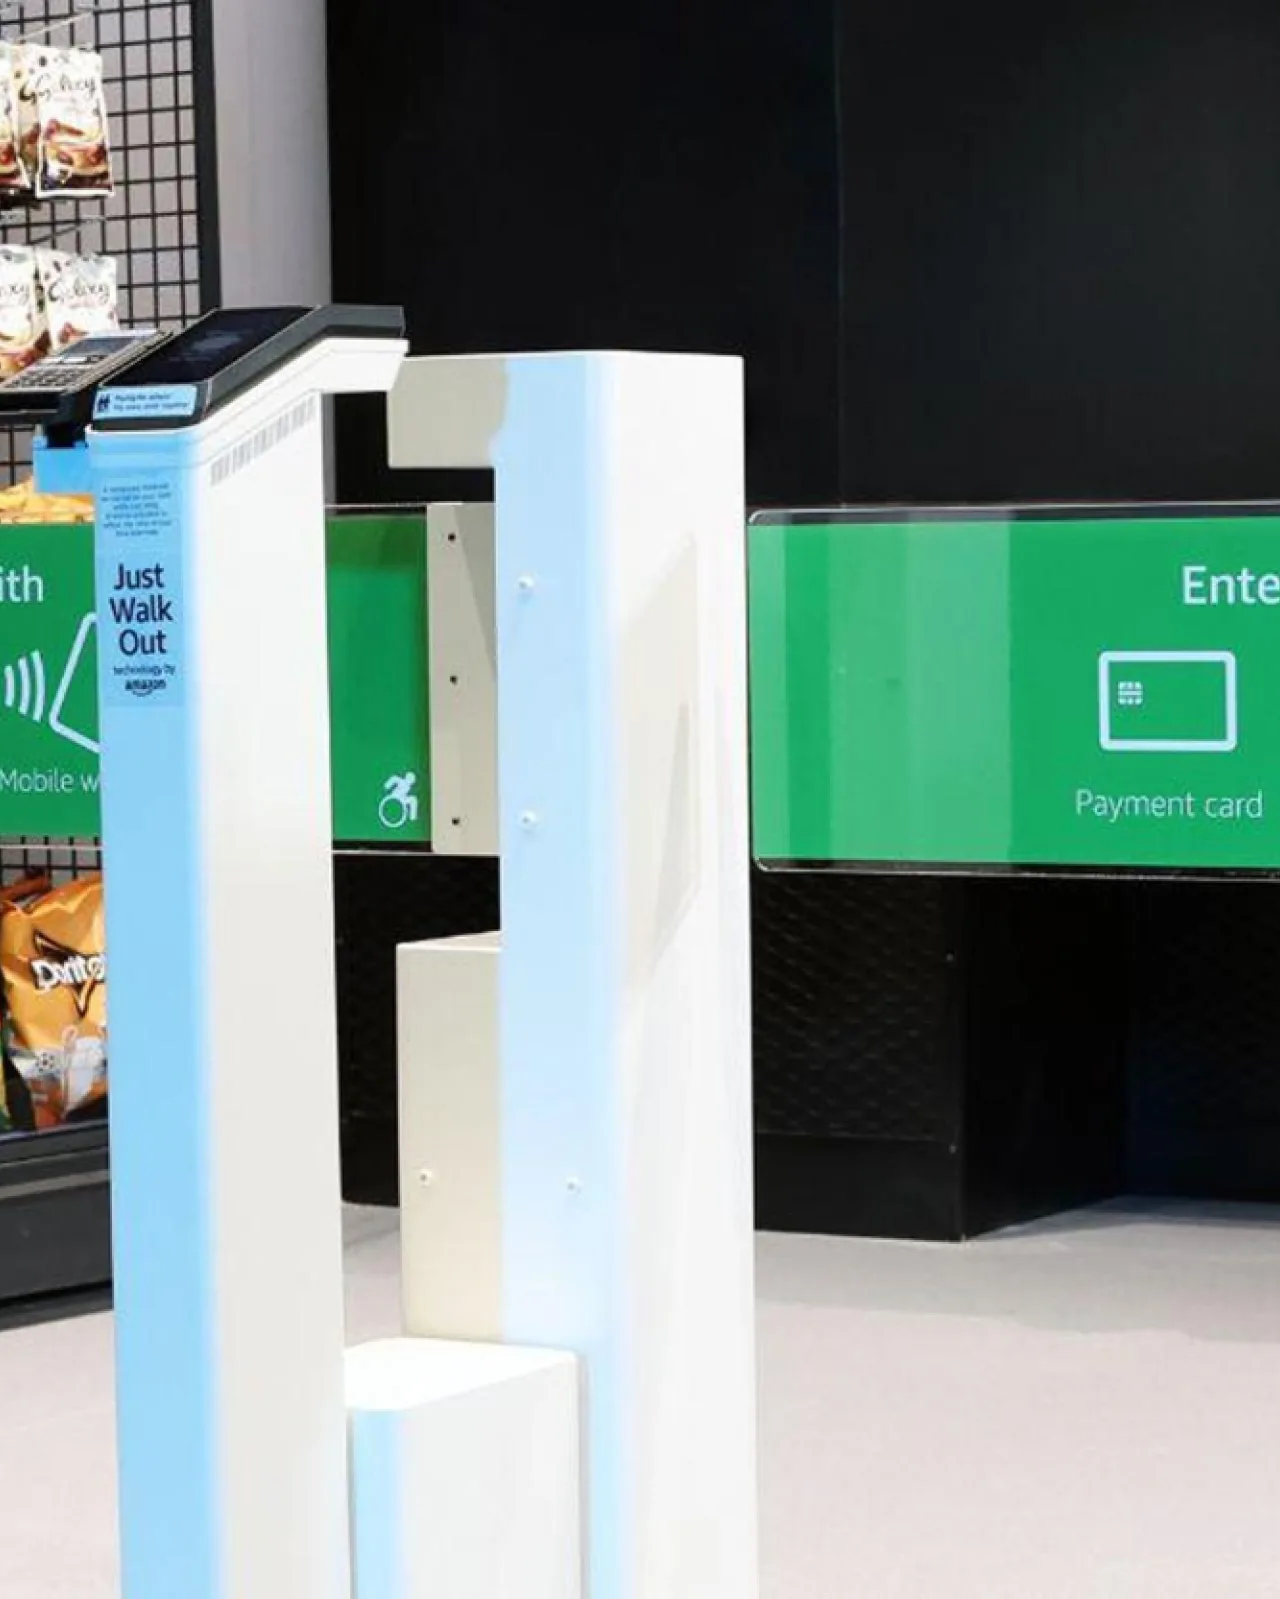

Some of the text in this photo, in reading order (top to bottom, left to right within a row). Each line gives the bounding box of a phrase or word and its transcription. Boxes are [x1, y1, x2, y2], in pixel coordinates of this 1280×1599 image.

[113, 563, 165, 591] Just
[109, 593, 174, 624] Walk
[119, 629, 167, 656] Out
[125, 679, 167, 696] amazon
[1075, 788, 1264, 823] Payment card
[30, 955, 106, 992] Dorito
